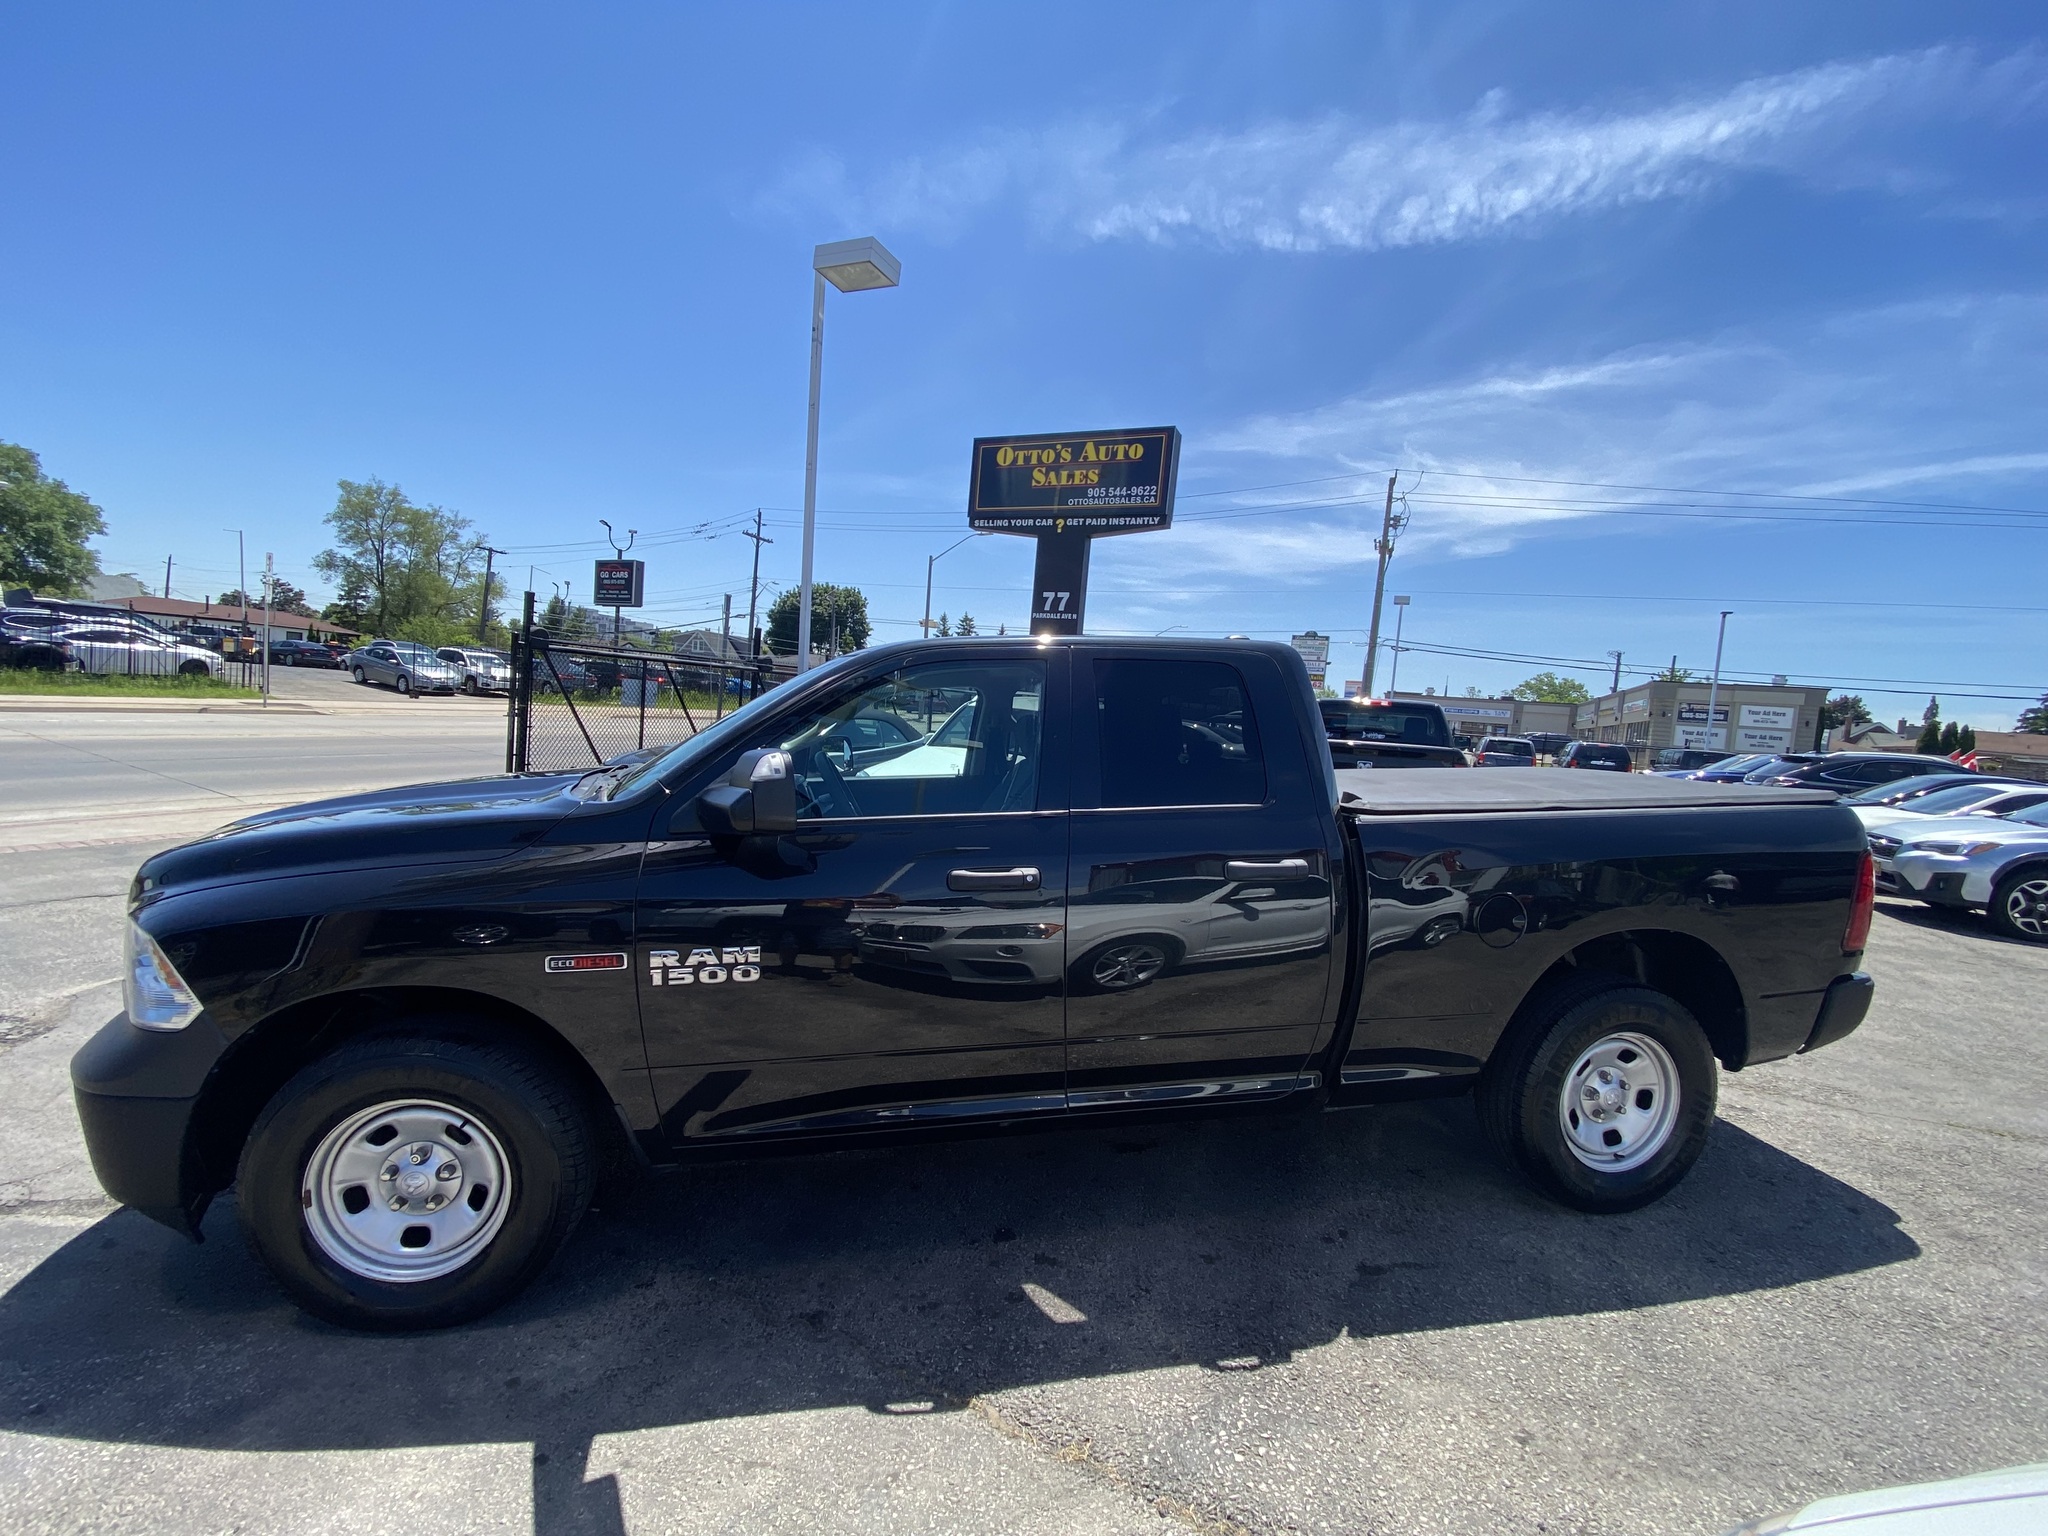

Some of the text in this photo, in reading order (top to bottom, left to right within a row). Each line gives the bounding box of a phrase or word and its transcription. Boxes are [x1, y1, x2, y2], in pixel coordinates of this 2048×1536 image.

[996, 441, 1144, 467] OTTO'S AUTO
[1031, 467, 1099, 487] SALES
[1067, 496, 1156, 506] OTTOSAUTOSALES.CA
[1087, 485, 1157, 497] 905 544-9622
[974, 519, 1009, 527] SELLING
[1035, 518, 1053, 526] CAR
[1066, 518, 1084, 526] GET
[1085, 517, 1107, 526] PAID
[1108, 516, 1160, 525] INSTANTLY
[1042, 591, 1070, 611] 77
[550, 955, 620, 969] ECODIESEL
[650, 945, 761, 967] RAM
[650, 964, 761, 986] 1500
